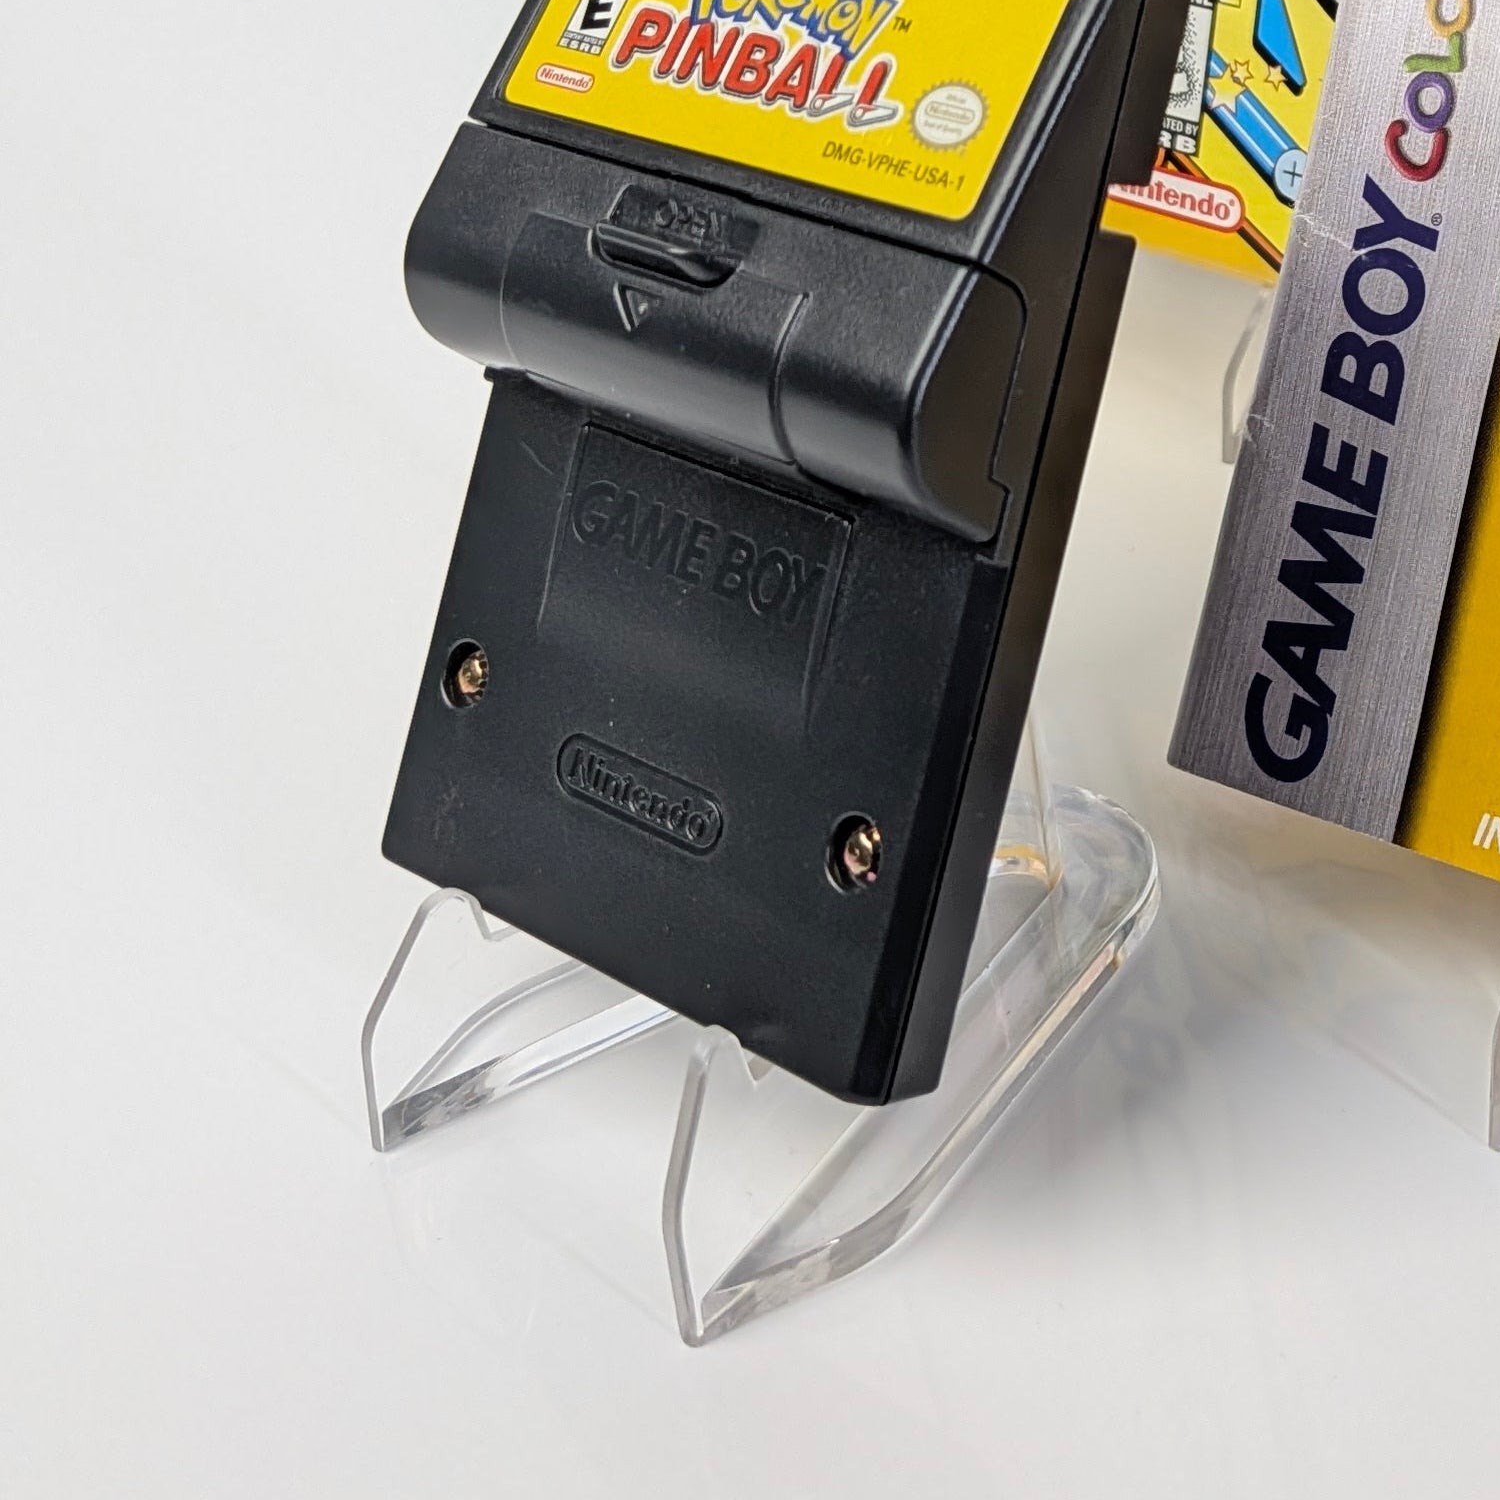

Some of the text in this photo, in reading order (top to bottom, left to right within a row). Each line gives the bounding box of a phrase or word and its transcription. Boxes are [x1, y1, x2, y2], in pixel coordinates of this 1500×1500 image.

[540, 66, 590, 90] Nintendo
[613, 6, 900, 128] PINBALL
[821, 141, 967, 192] DMG-VPHE-USA-1
[1245, 422, 1389, 784] GAME
[1319, 172, 1441, 427] BOY
[571, 479, 829, 621] GAME BOY
[567, 746, 707, 840] Nintendo
